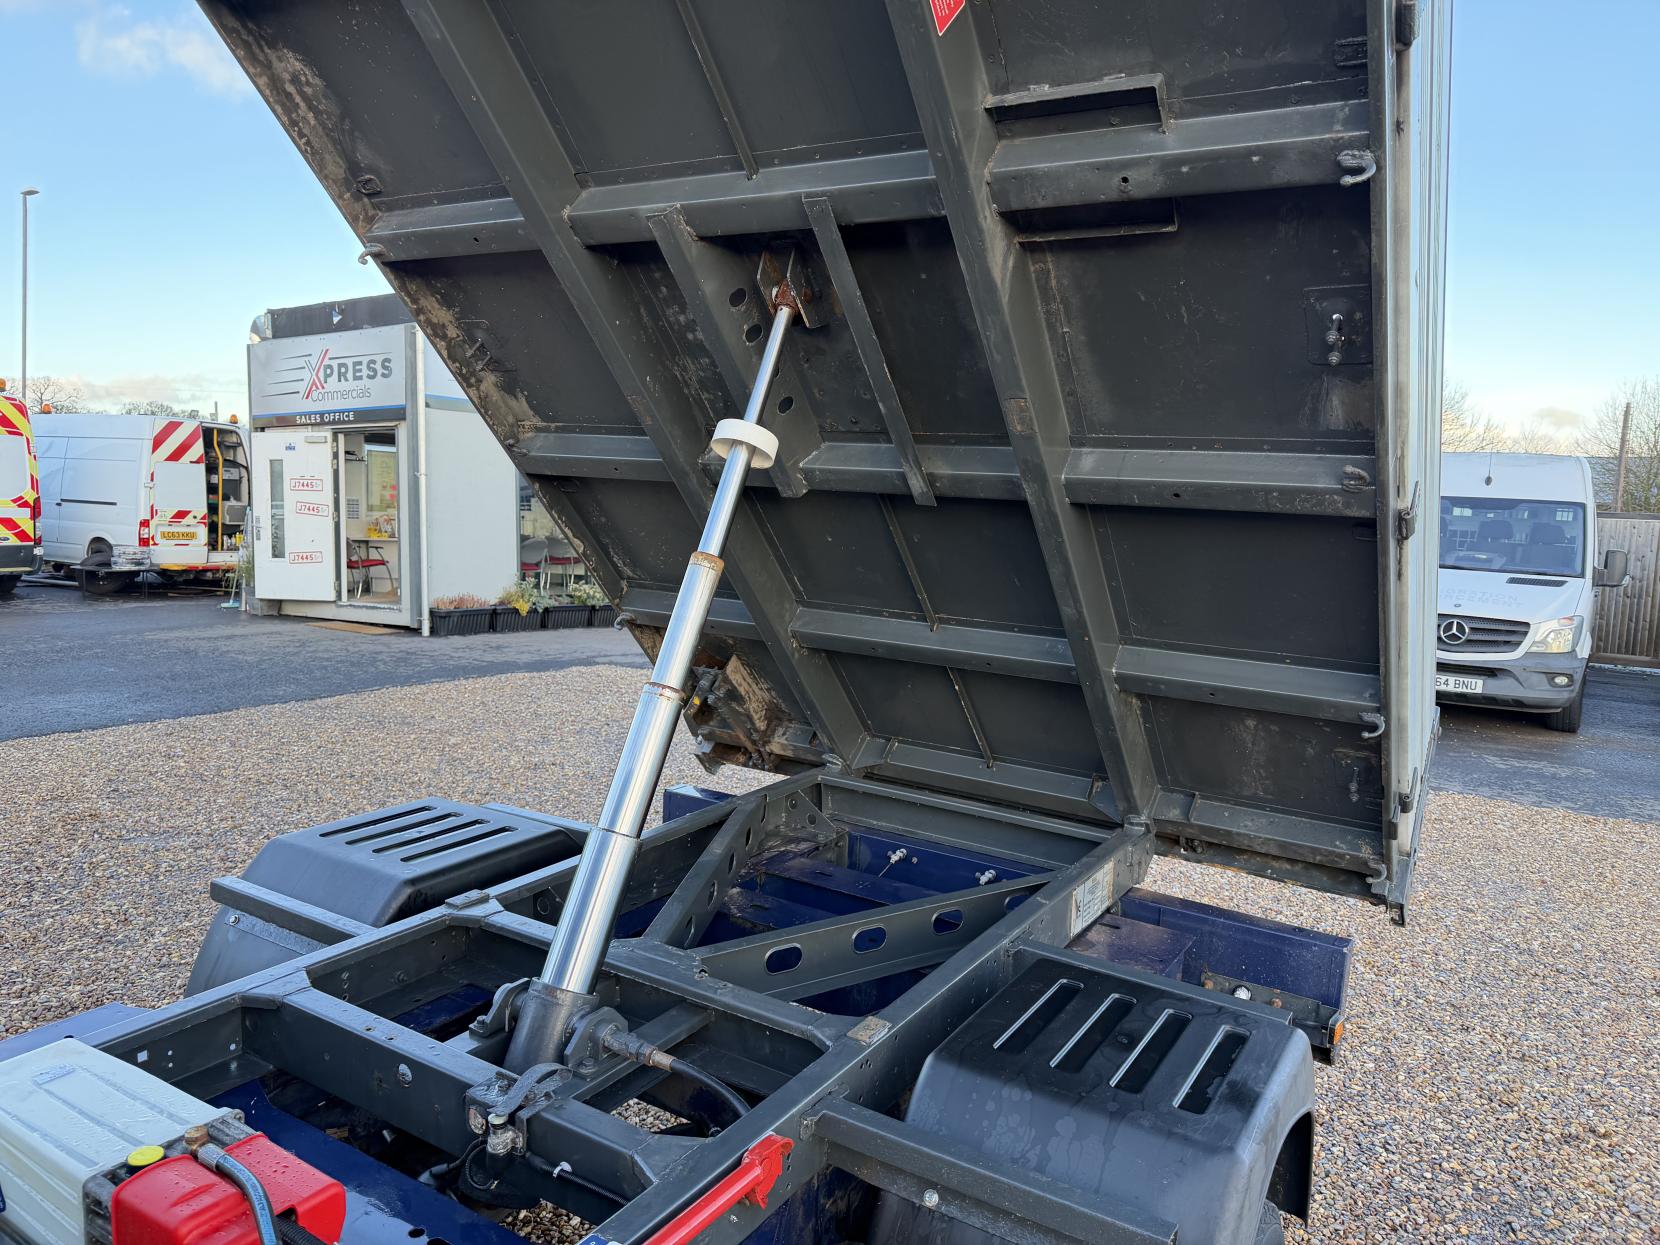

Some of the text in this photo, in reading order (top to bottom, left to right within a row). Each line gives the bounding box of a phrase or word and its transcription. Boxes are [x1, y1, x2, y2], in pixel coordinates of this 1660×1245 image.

[302, 348, 393, 401] XPRESS
[310, 384, 372, 403] Commercials
[295, 411, 355, 424] SALES OFFICE
[1435, 677, 1478, 691] 64 BNU
